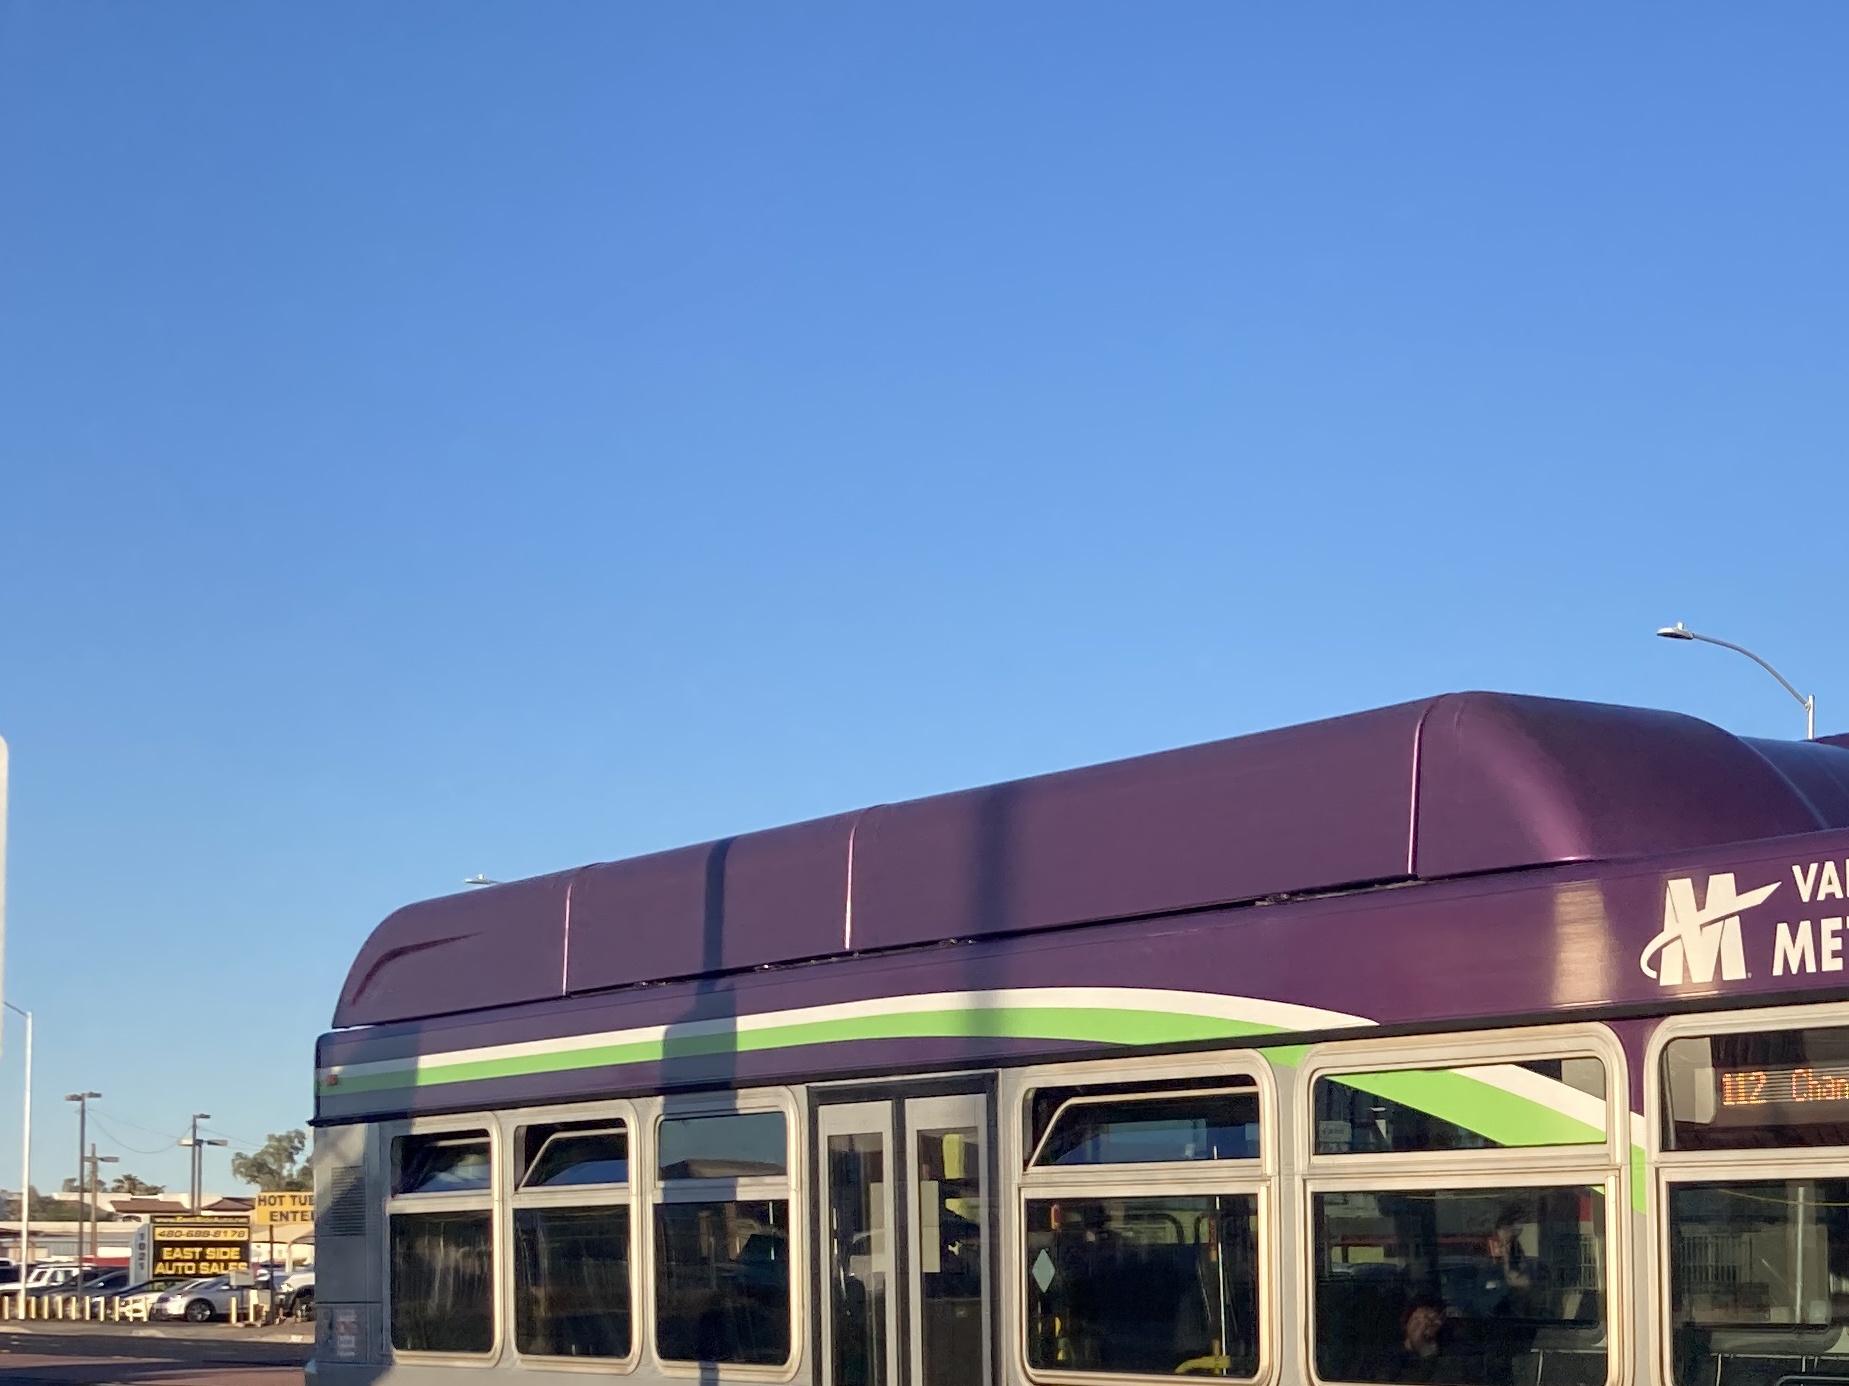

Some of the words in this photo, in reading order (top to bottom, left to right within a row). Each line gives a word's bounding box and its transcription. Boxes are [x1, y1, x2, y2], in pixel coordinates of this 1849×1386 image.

[1722, 1070, 1767, 1106] 112
[257, 1194, 286, 1207] HOT
[269, 1210, 315, 1222] ENTE
[162, 1247, 203, 1260] EAST
[205, 1247, 241, 1260] SIDE
[154, 1261, 196, 1275] AUTO
